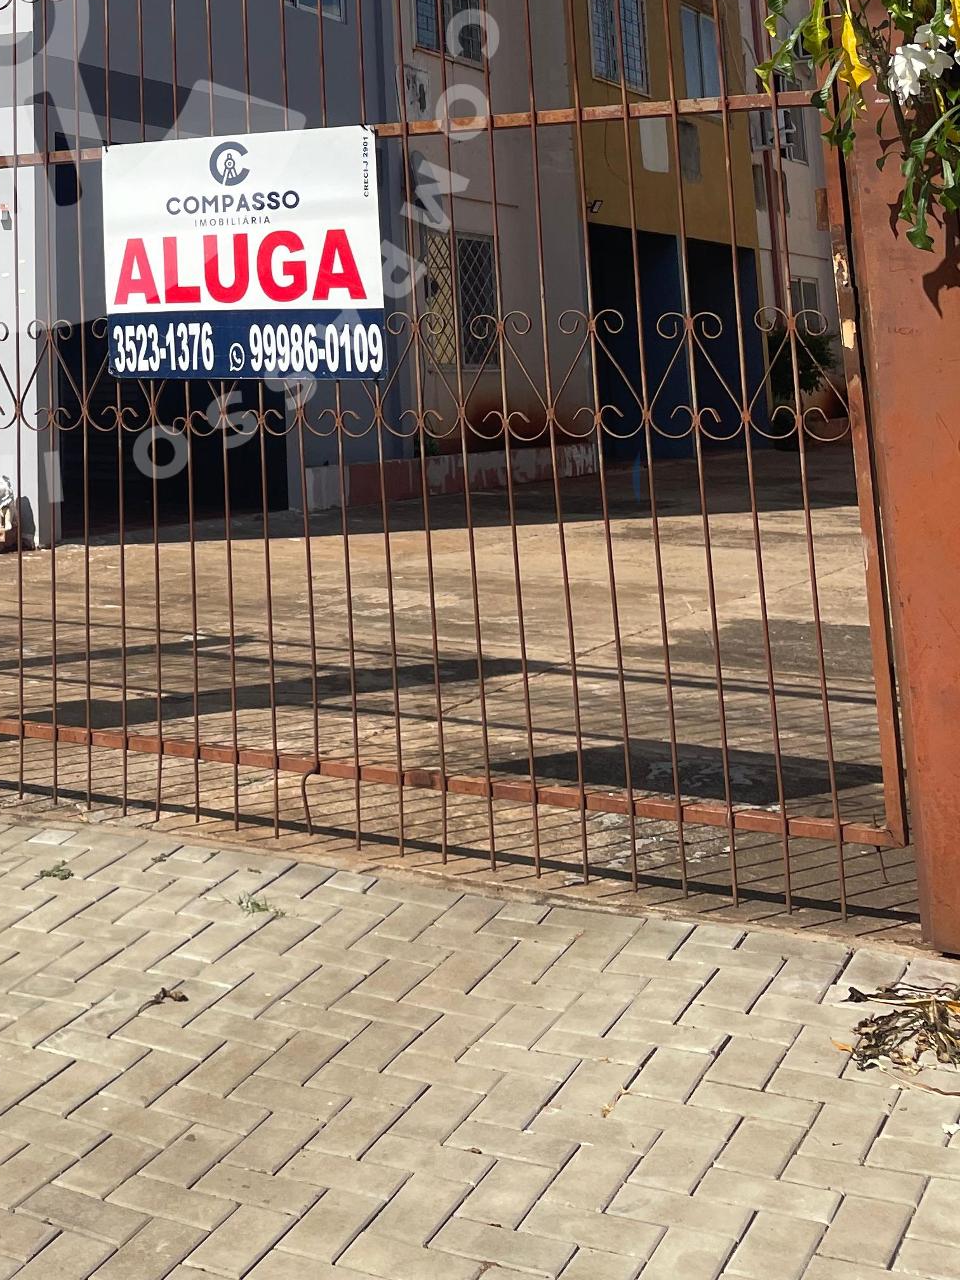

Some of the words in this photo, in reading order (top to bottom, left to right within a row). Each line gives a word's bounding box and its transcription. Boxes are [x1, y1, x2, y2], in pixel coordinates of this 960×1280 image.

[166, 190, 300, 216] COMPASSO
[114, 228, 368, 305] ALUGA
[112, 322, 215, 373] 3523-1376
[248, 323, 384, 373] 99986-0109
